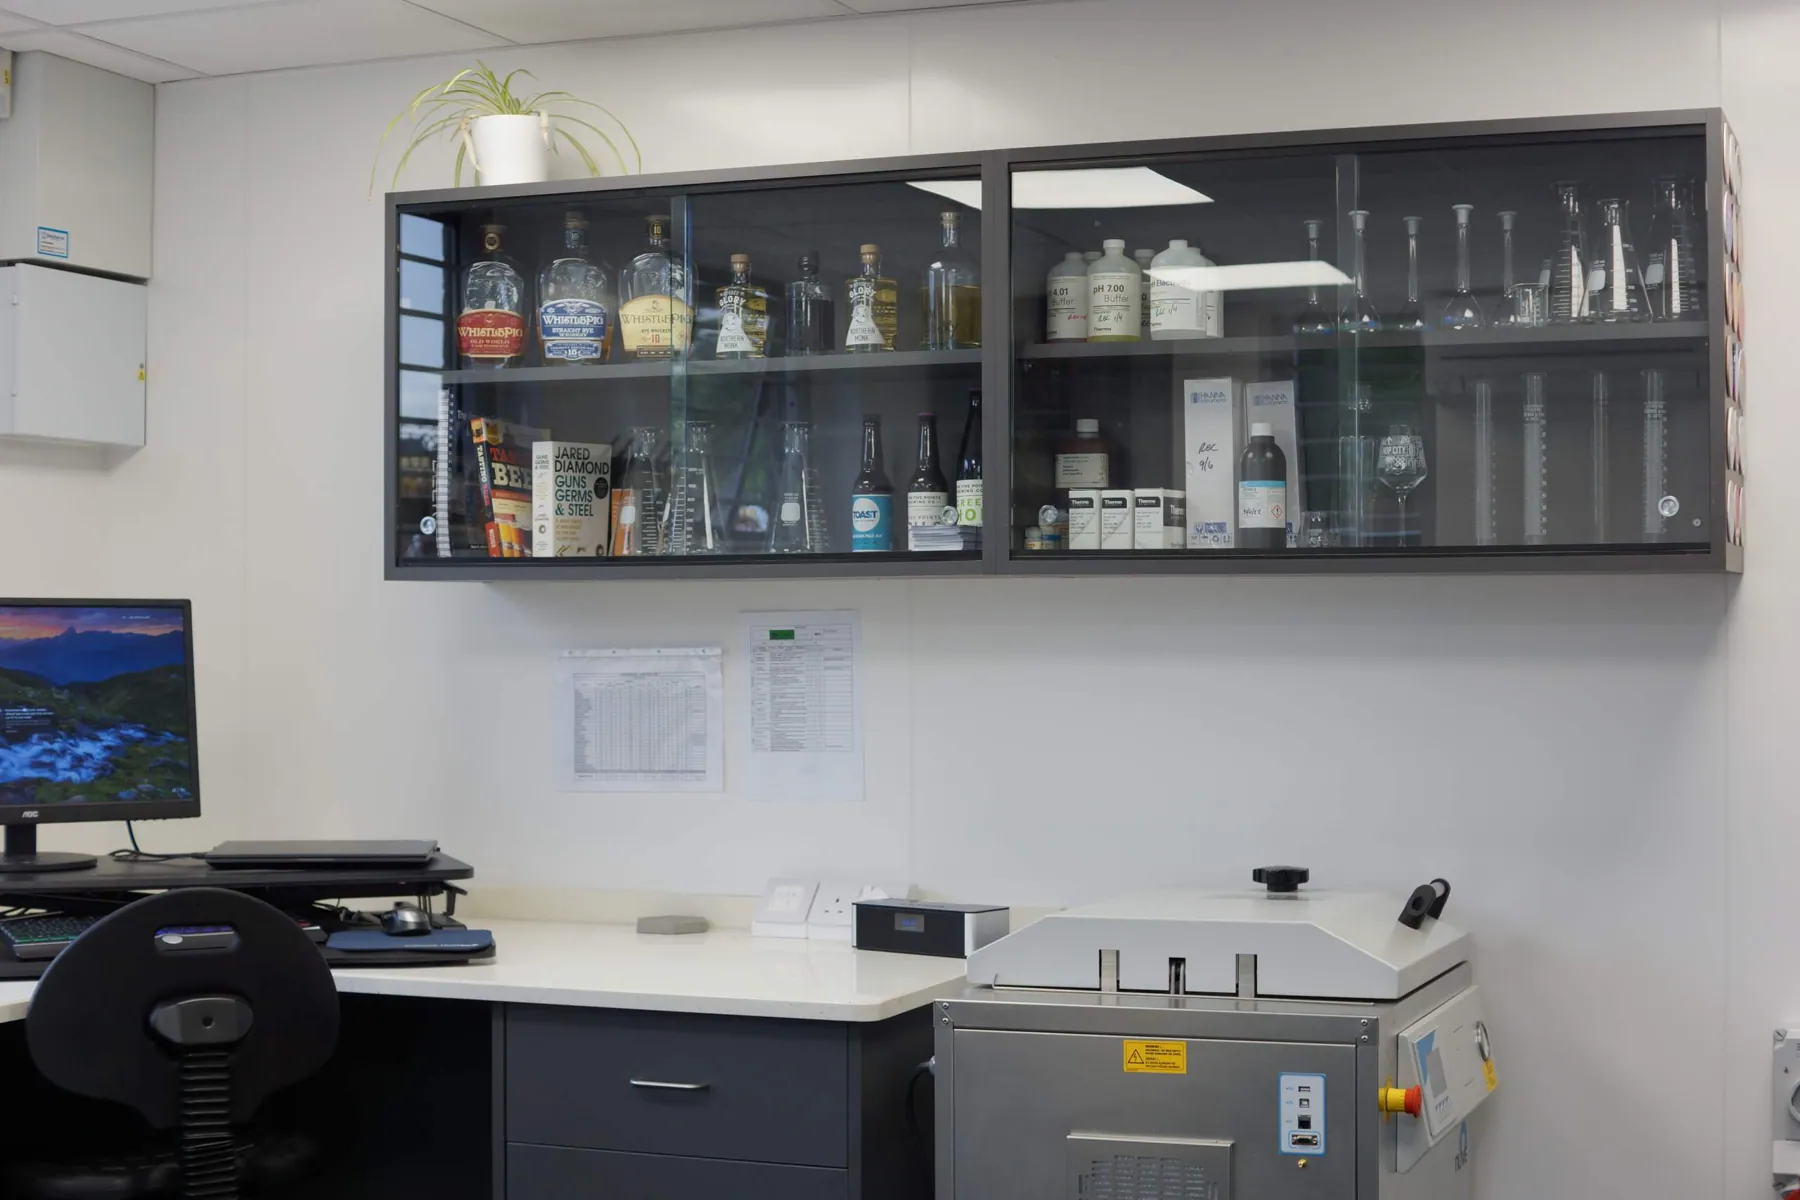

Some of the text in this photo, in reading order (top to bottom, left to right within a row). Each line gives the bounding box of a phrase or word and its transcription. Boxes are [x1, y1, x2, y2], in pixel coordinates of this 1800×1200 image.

[1053, 287, 1069, 296] 4.01
[1093, 284, 1125, 295] pH 7.00
[719, 295, 747, 307] GLORY
[1103, 294, 1129, 303] Buffer
[542, 315, 604, 326] WHISTLEPIG
[457, 326, 524, 338] WHISTLEPIG
[1200, 391, 1226, 399] HANNA
[554, 446, 591, 461] JARED
[554, 459, 610, 475] DIAMOND
[554, 474, 588, 489] GUNS
[554, 488, 594, 503] GERMS
[554, 502, 594, 517] & STEEL
[853, 510, 878, 519] TOAST
